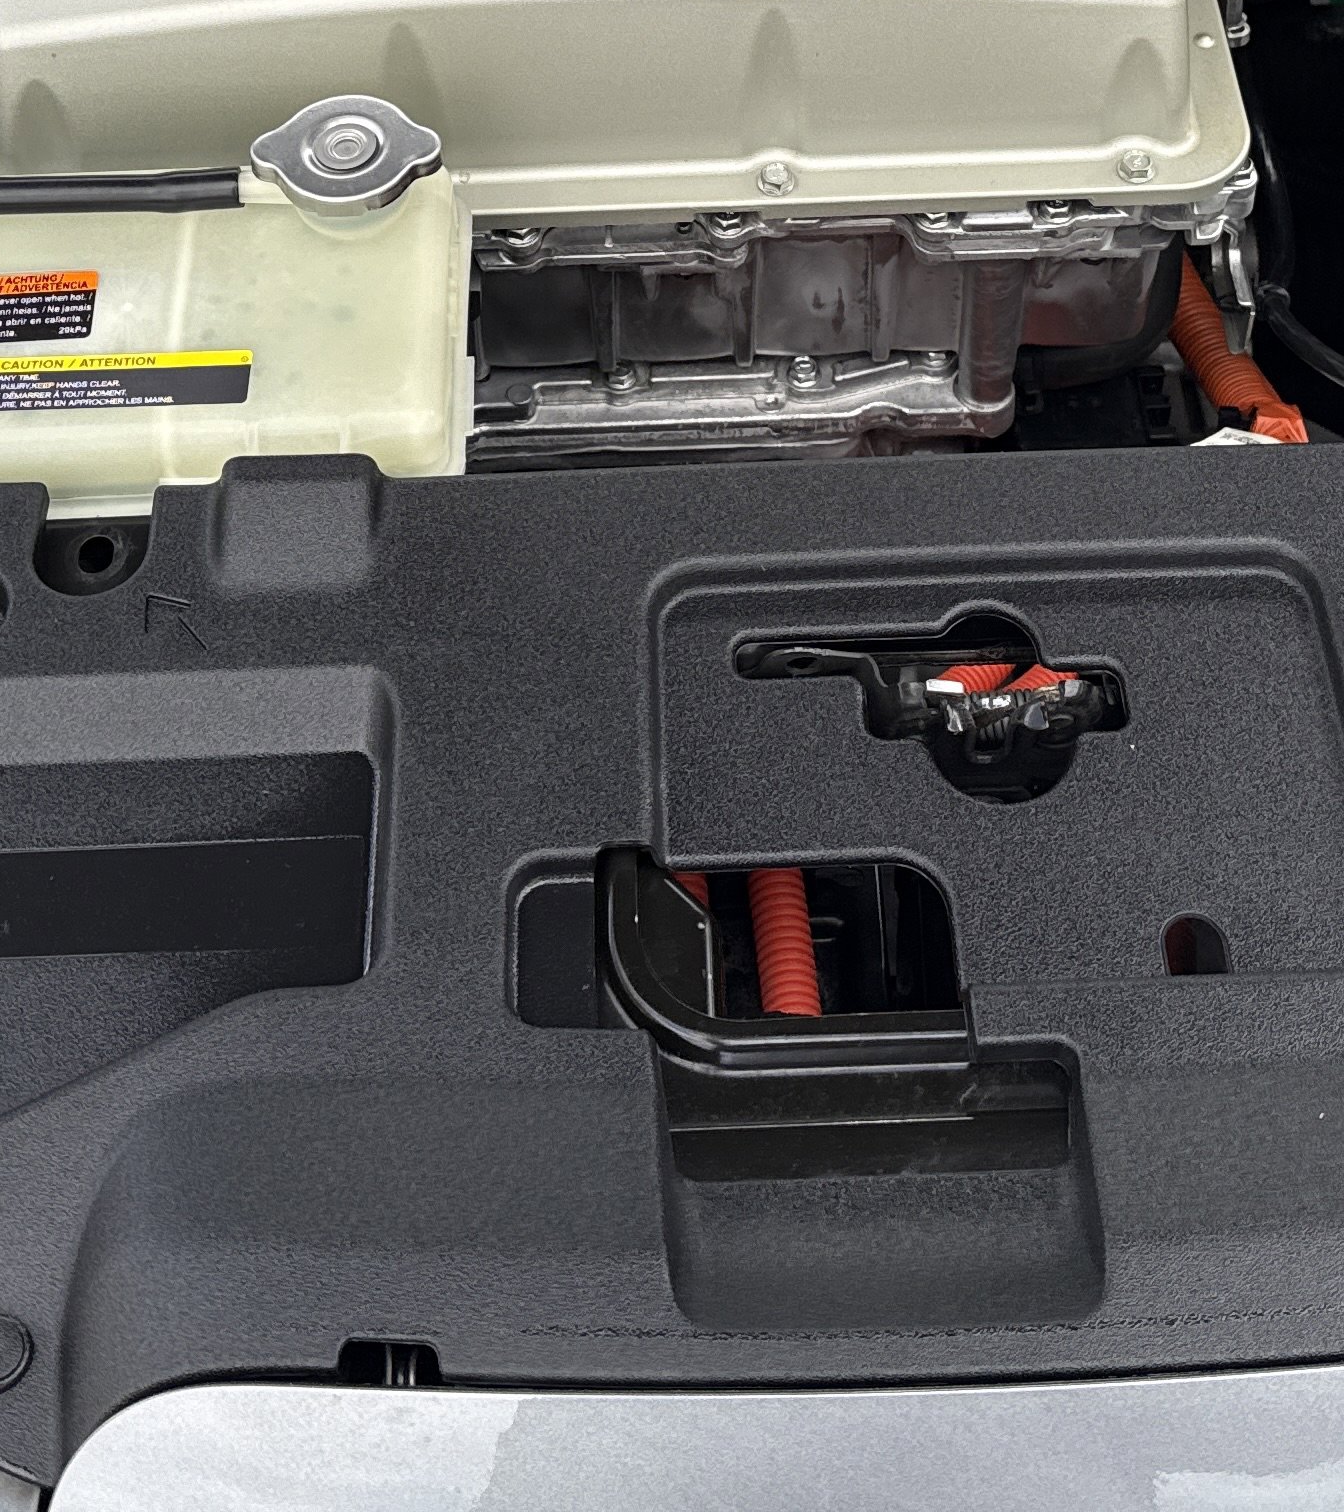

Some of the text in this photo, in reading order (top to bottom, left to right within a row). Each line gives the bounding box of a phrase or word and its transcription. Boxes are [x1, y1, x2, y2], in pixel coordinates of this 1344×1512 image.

[5, 274, 57, 285] ACHTUNG
[20, 295, 43, 304] open
[44, 294, 68, 302] when
[47, 305, 59, 313] Ne
[60, 303, 92, 315] jamais
[6, 317, 26, 326] abrir
[29, 316, 42, 325] en
[1, 356, 156, 370] CAUTION / ATTENTION
[62, 390, 85, 398] TOUT
[68, 398, 124, 406] APPROCHER
